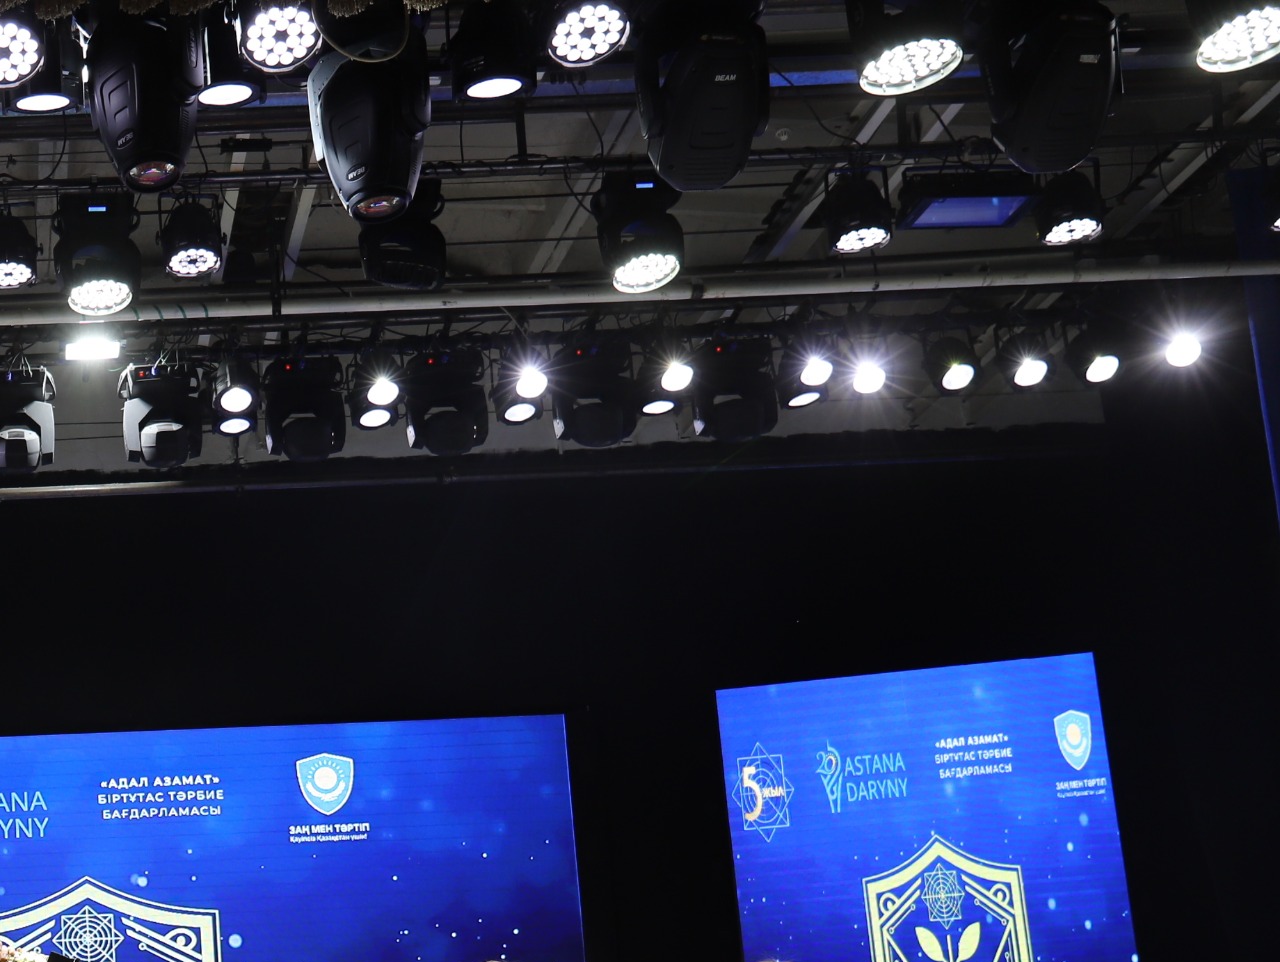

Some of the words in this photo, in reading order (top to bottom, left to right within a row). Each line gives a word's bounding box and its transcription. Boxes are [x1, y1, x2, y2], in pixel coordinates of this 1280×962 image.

[845, 752, 906, 777] ASTANA
[100, 777, 148, 790] «АДАЛ
[153, 774, 220, 787] АЗАМАТ»
[846, 778, 908, 802] DARYNY
[98, 792, 164, 805] БІРТҰТАС
[168, 789, 224, 802] ТӘРБИЕ
[742, 766, 763, 821] 5
[102, 805, 221, 820] БАҒДАРЛАМАСЫ
[289, 825, 310, 835] ЗАҢ
[311, 824, 333, 834] МЕН
